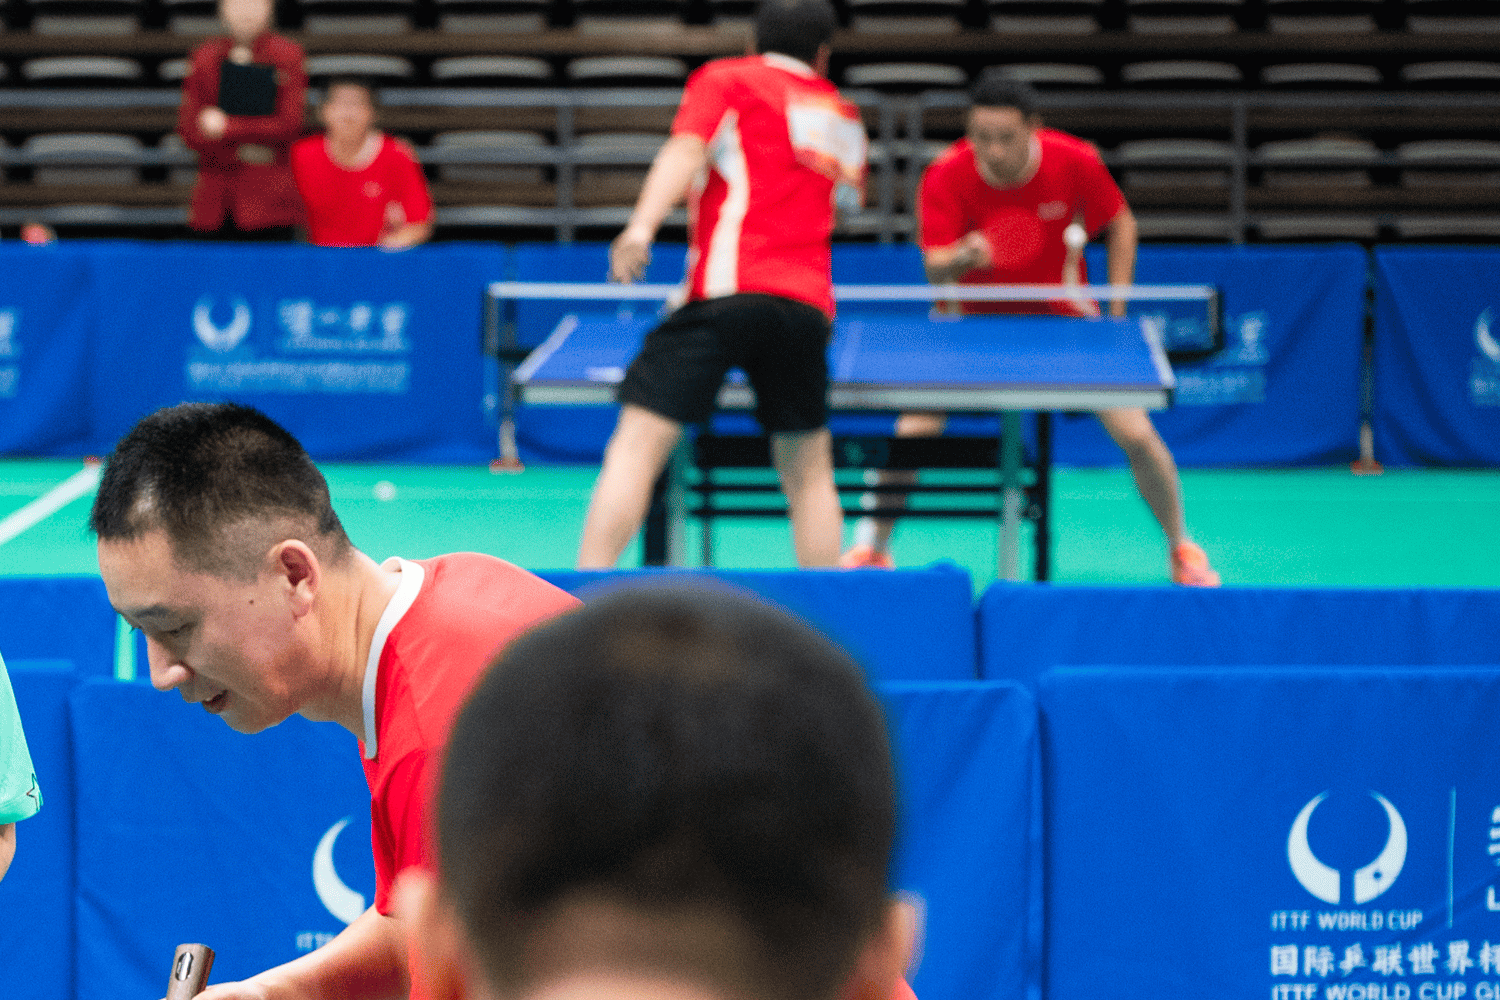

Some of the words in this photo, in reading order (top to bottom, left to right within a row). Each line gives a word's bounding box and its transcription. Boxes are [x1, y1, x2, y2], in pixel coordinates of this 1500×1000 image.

[1270, 910, 1310, 931] ITTF
[1316, 910, 1384, 931] WORLD
[1387, 910, 1423, 931] CUP
